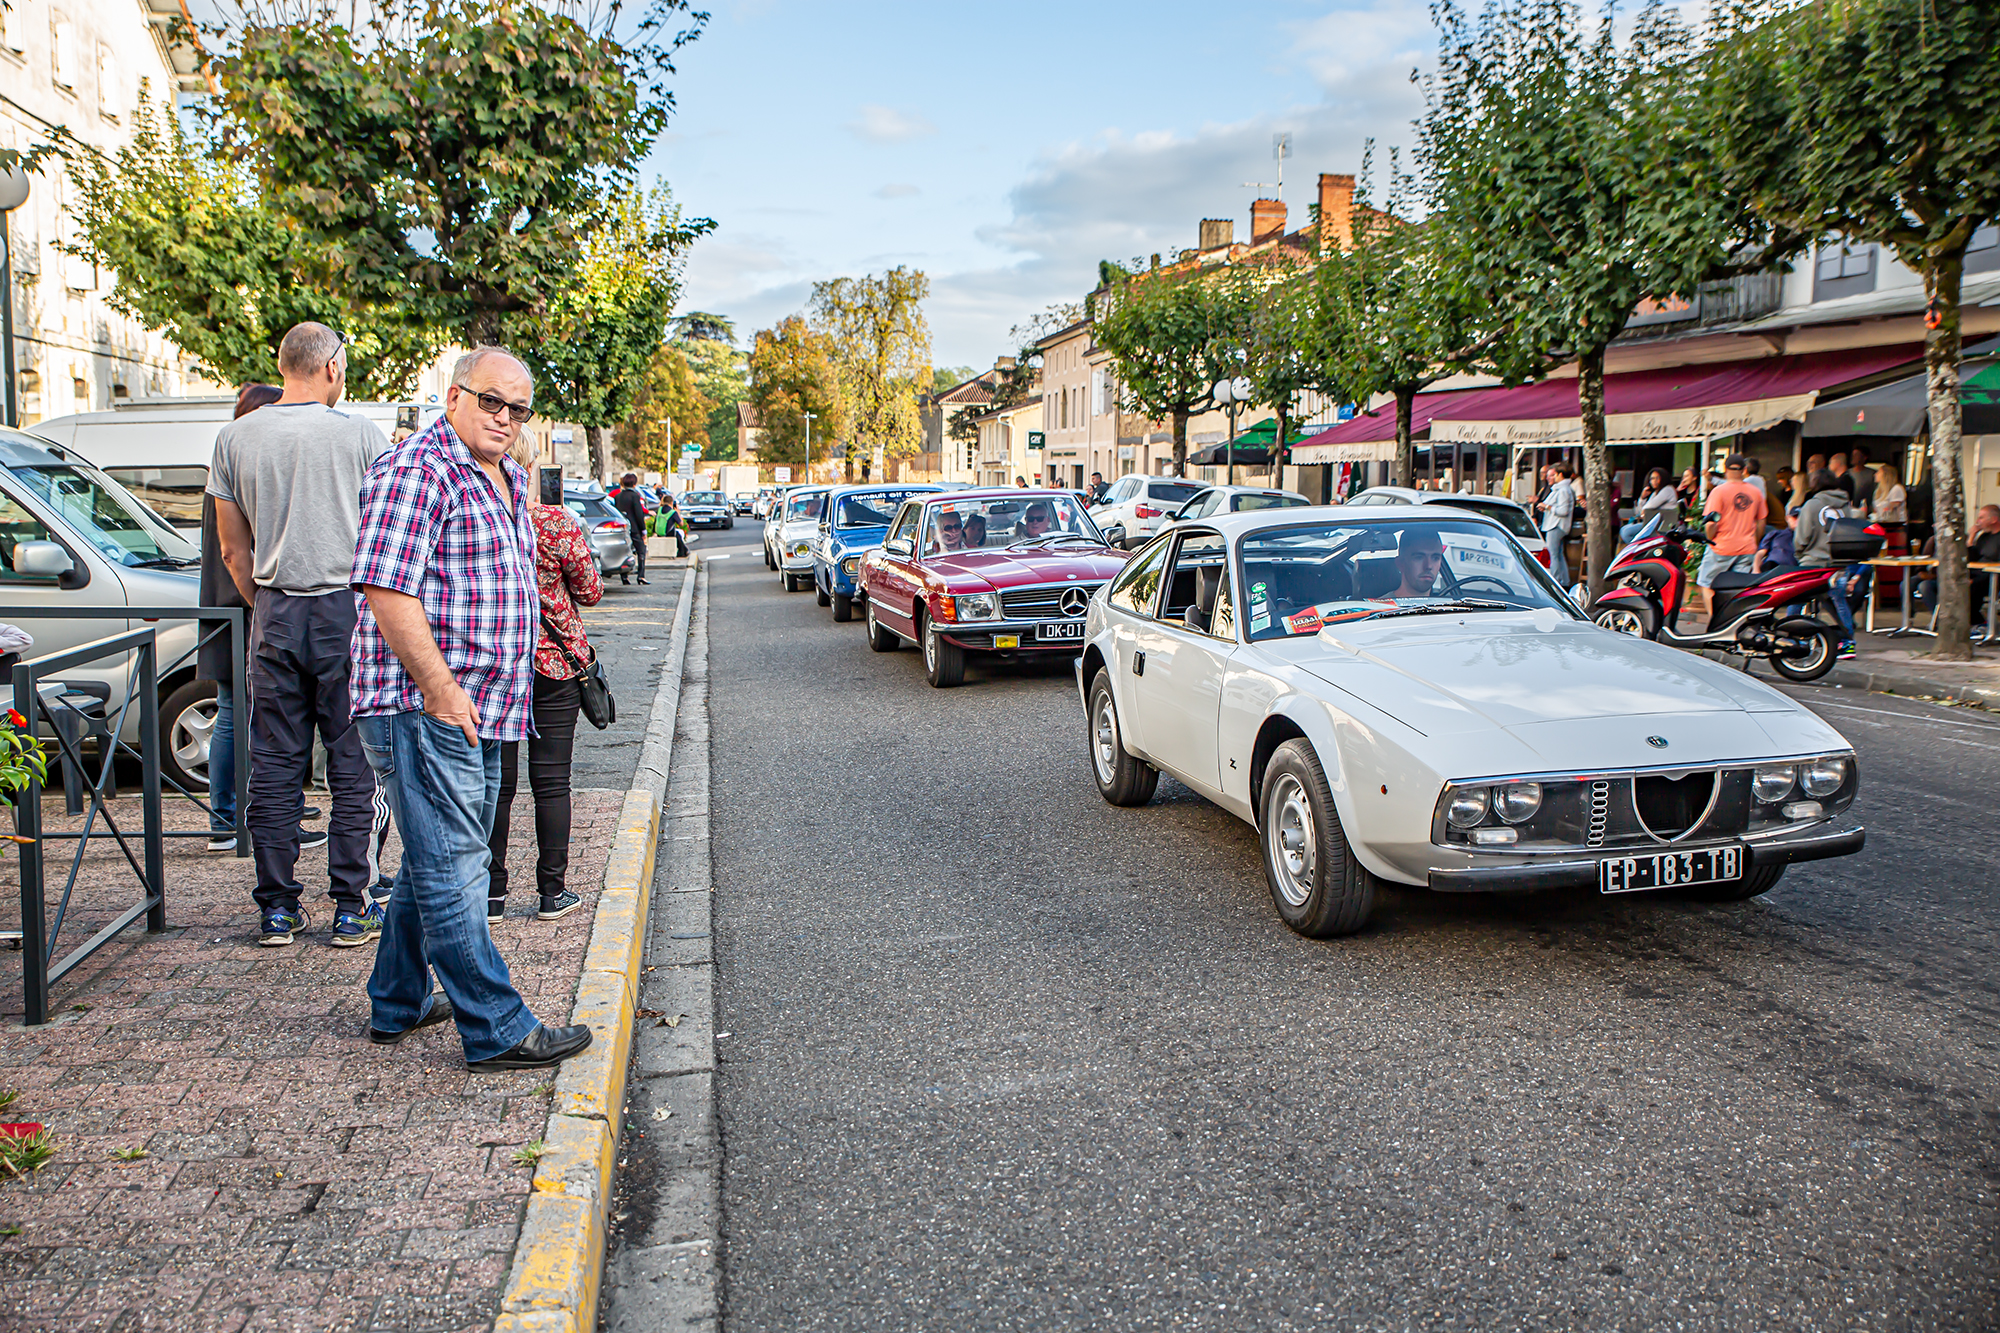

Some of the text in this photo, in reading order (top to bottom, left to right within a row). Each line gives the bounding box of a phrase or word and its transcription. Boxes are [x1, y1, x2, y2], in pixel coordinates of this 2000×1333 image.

[1640, 417, 1667, 435] Bar
[851, 493, 886, 502] Renault
[1046, 624, 1086, 637] DK-01
[1607, 848, 1736, 891] EP-183-TB
